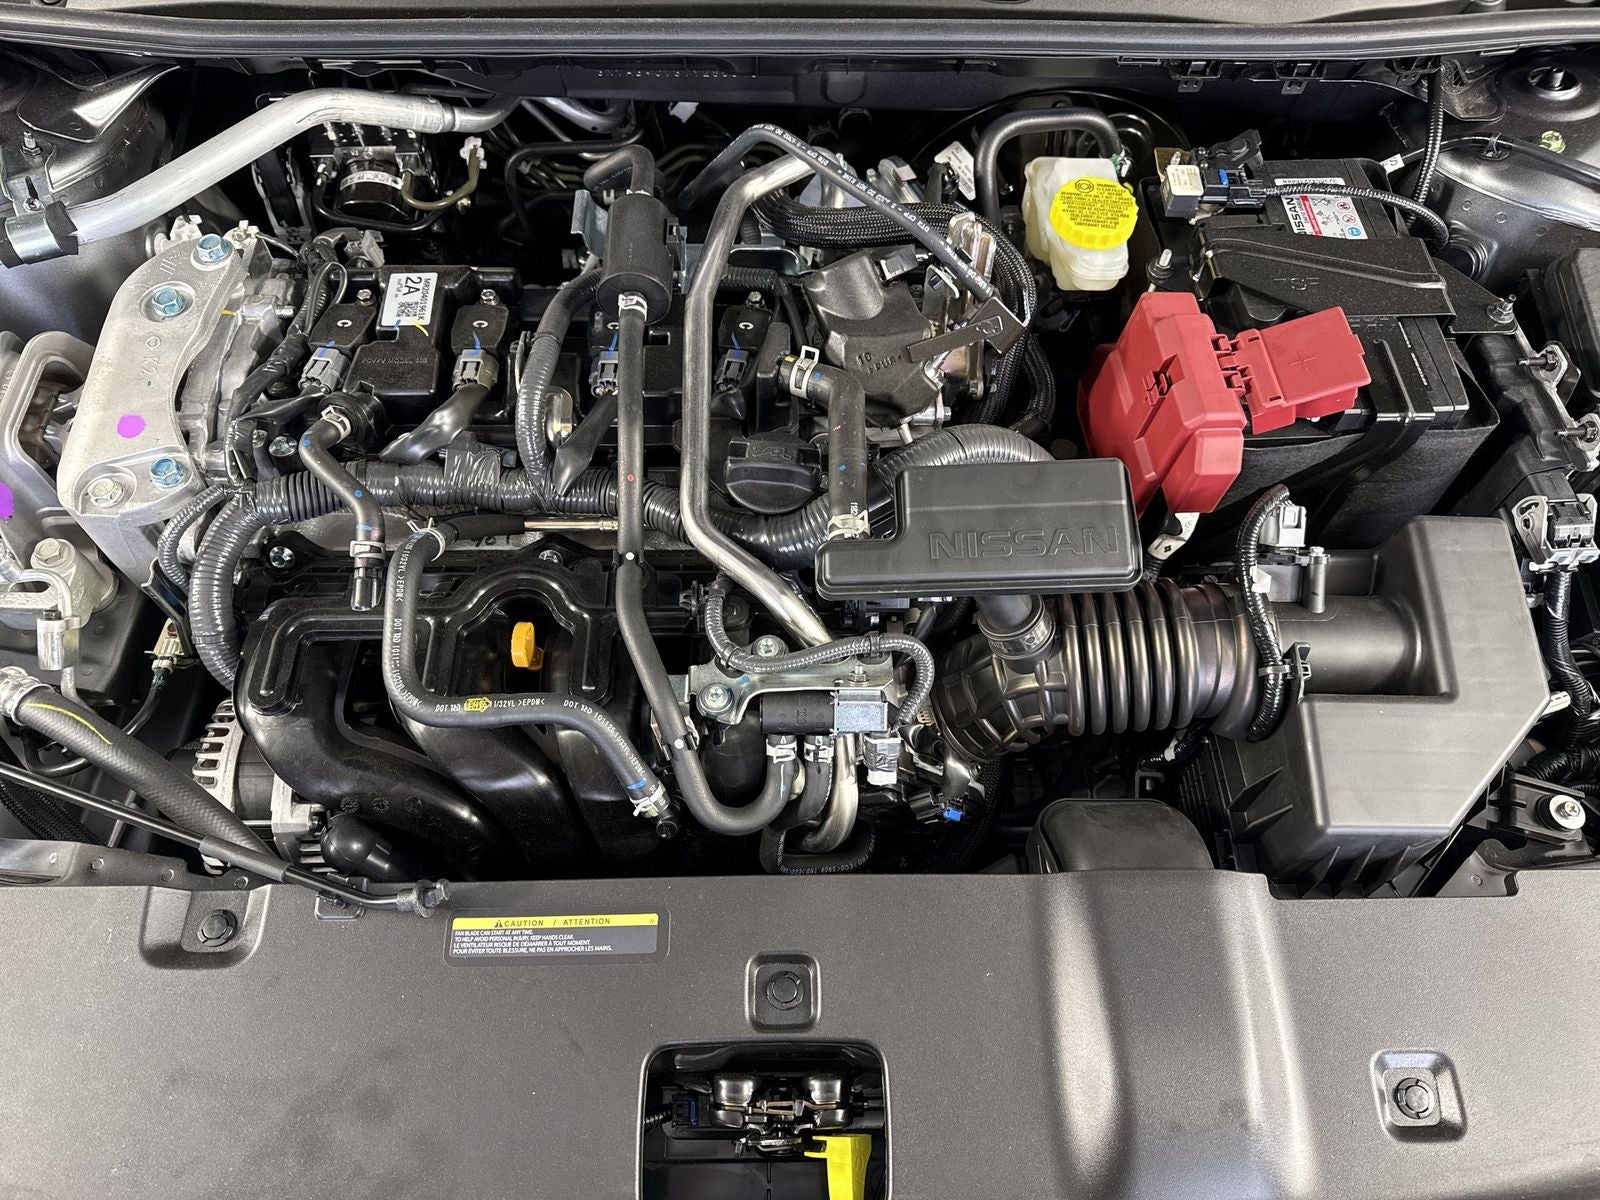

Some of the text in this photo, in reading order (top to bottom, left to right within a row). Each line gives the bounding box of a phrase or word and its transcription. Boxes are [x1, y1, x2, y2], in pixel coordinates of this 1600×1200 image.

[402, 276, 423, 296] 2A
[929, 527, 1120, 560] NISSAN
[504, 919, 544, 928] CAUTION
[563, 918, 611, 926] ATTENTION
